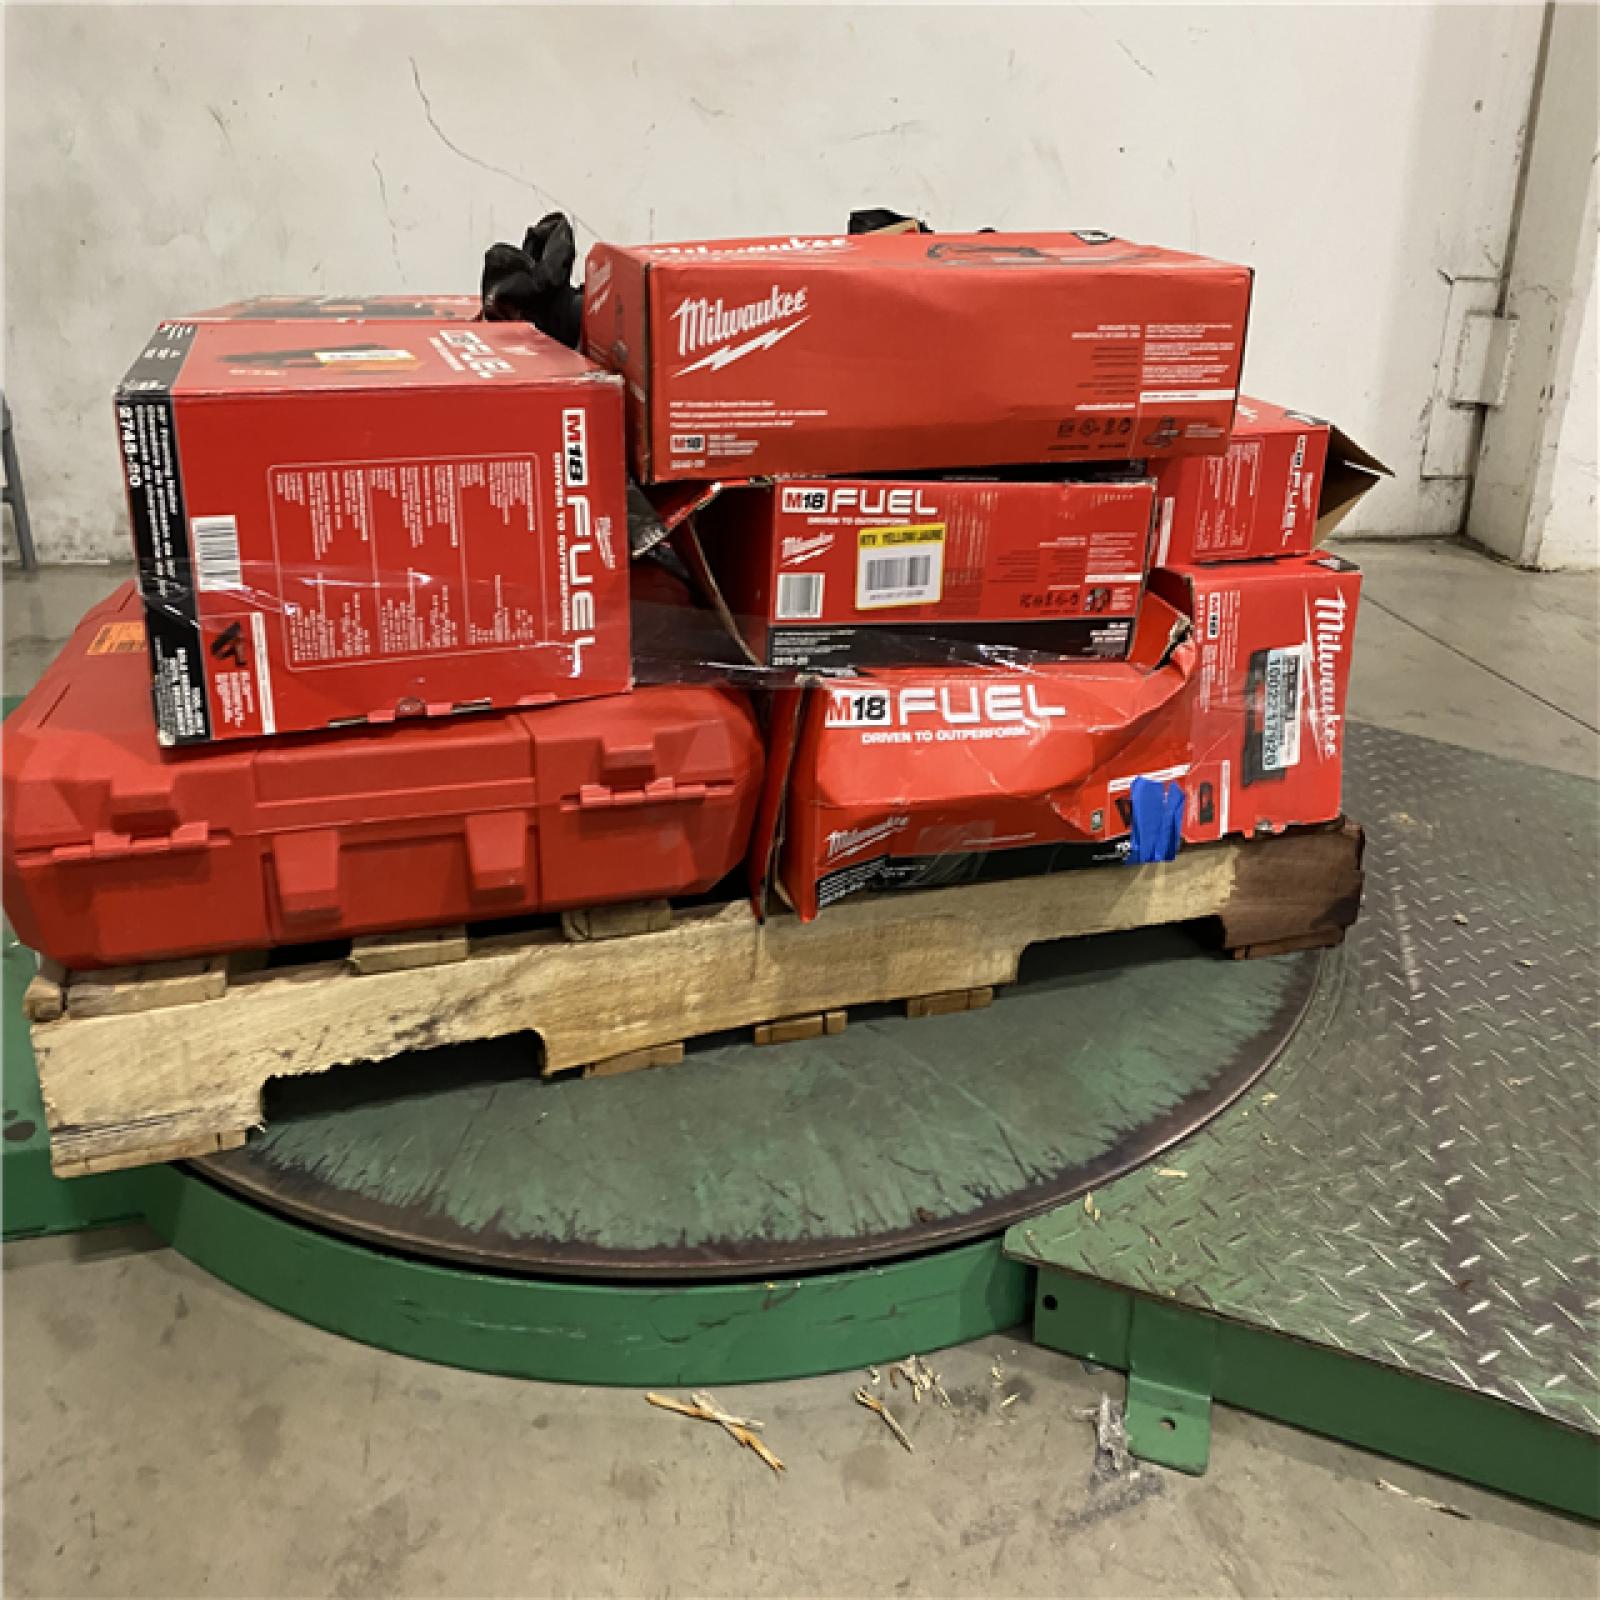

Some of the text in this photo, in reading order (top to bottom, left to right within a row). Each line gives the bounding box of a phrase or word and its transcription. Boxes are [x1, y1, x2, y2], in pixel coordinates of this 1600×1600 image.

[671, 284, 808, 356] Milwaukee
[784, 489, 938, 516] M18 FUEL
[565, 412, 596, 678] M18 FUEL
[1314, 588, 1347, 759] Milwaukee
[826, 684, 1066, 726] M18 FUEL
[862, 731, 911, 745] DRIVEN
[914, 730, 934, 743] TO
